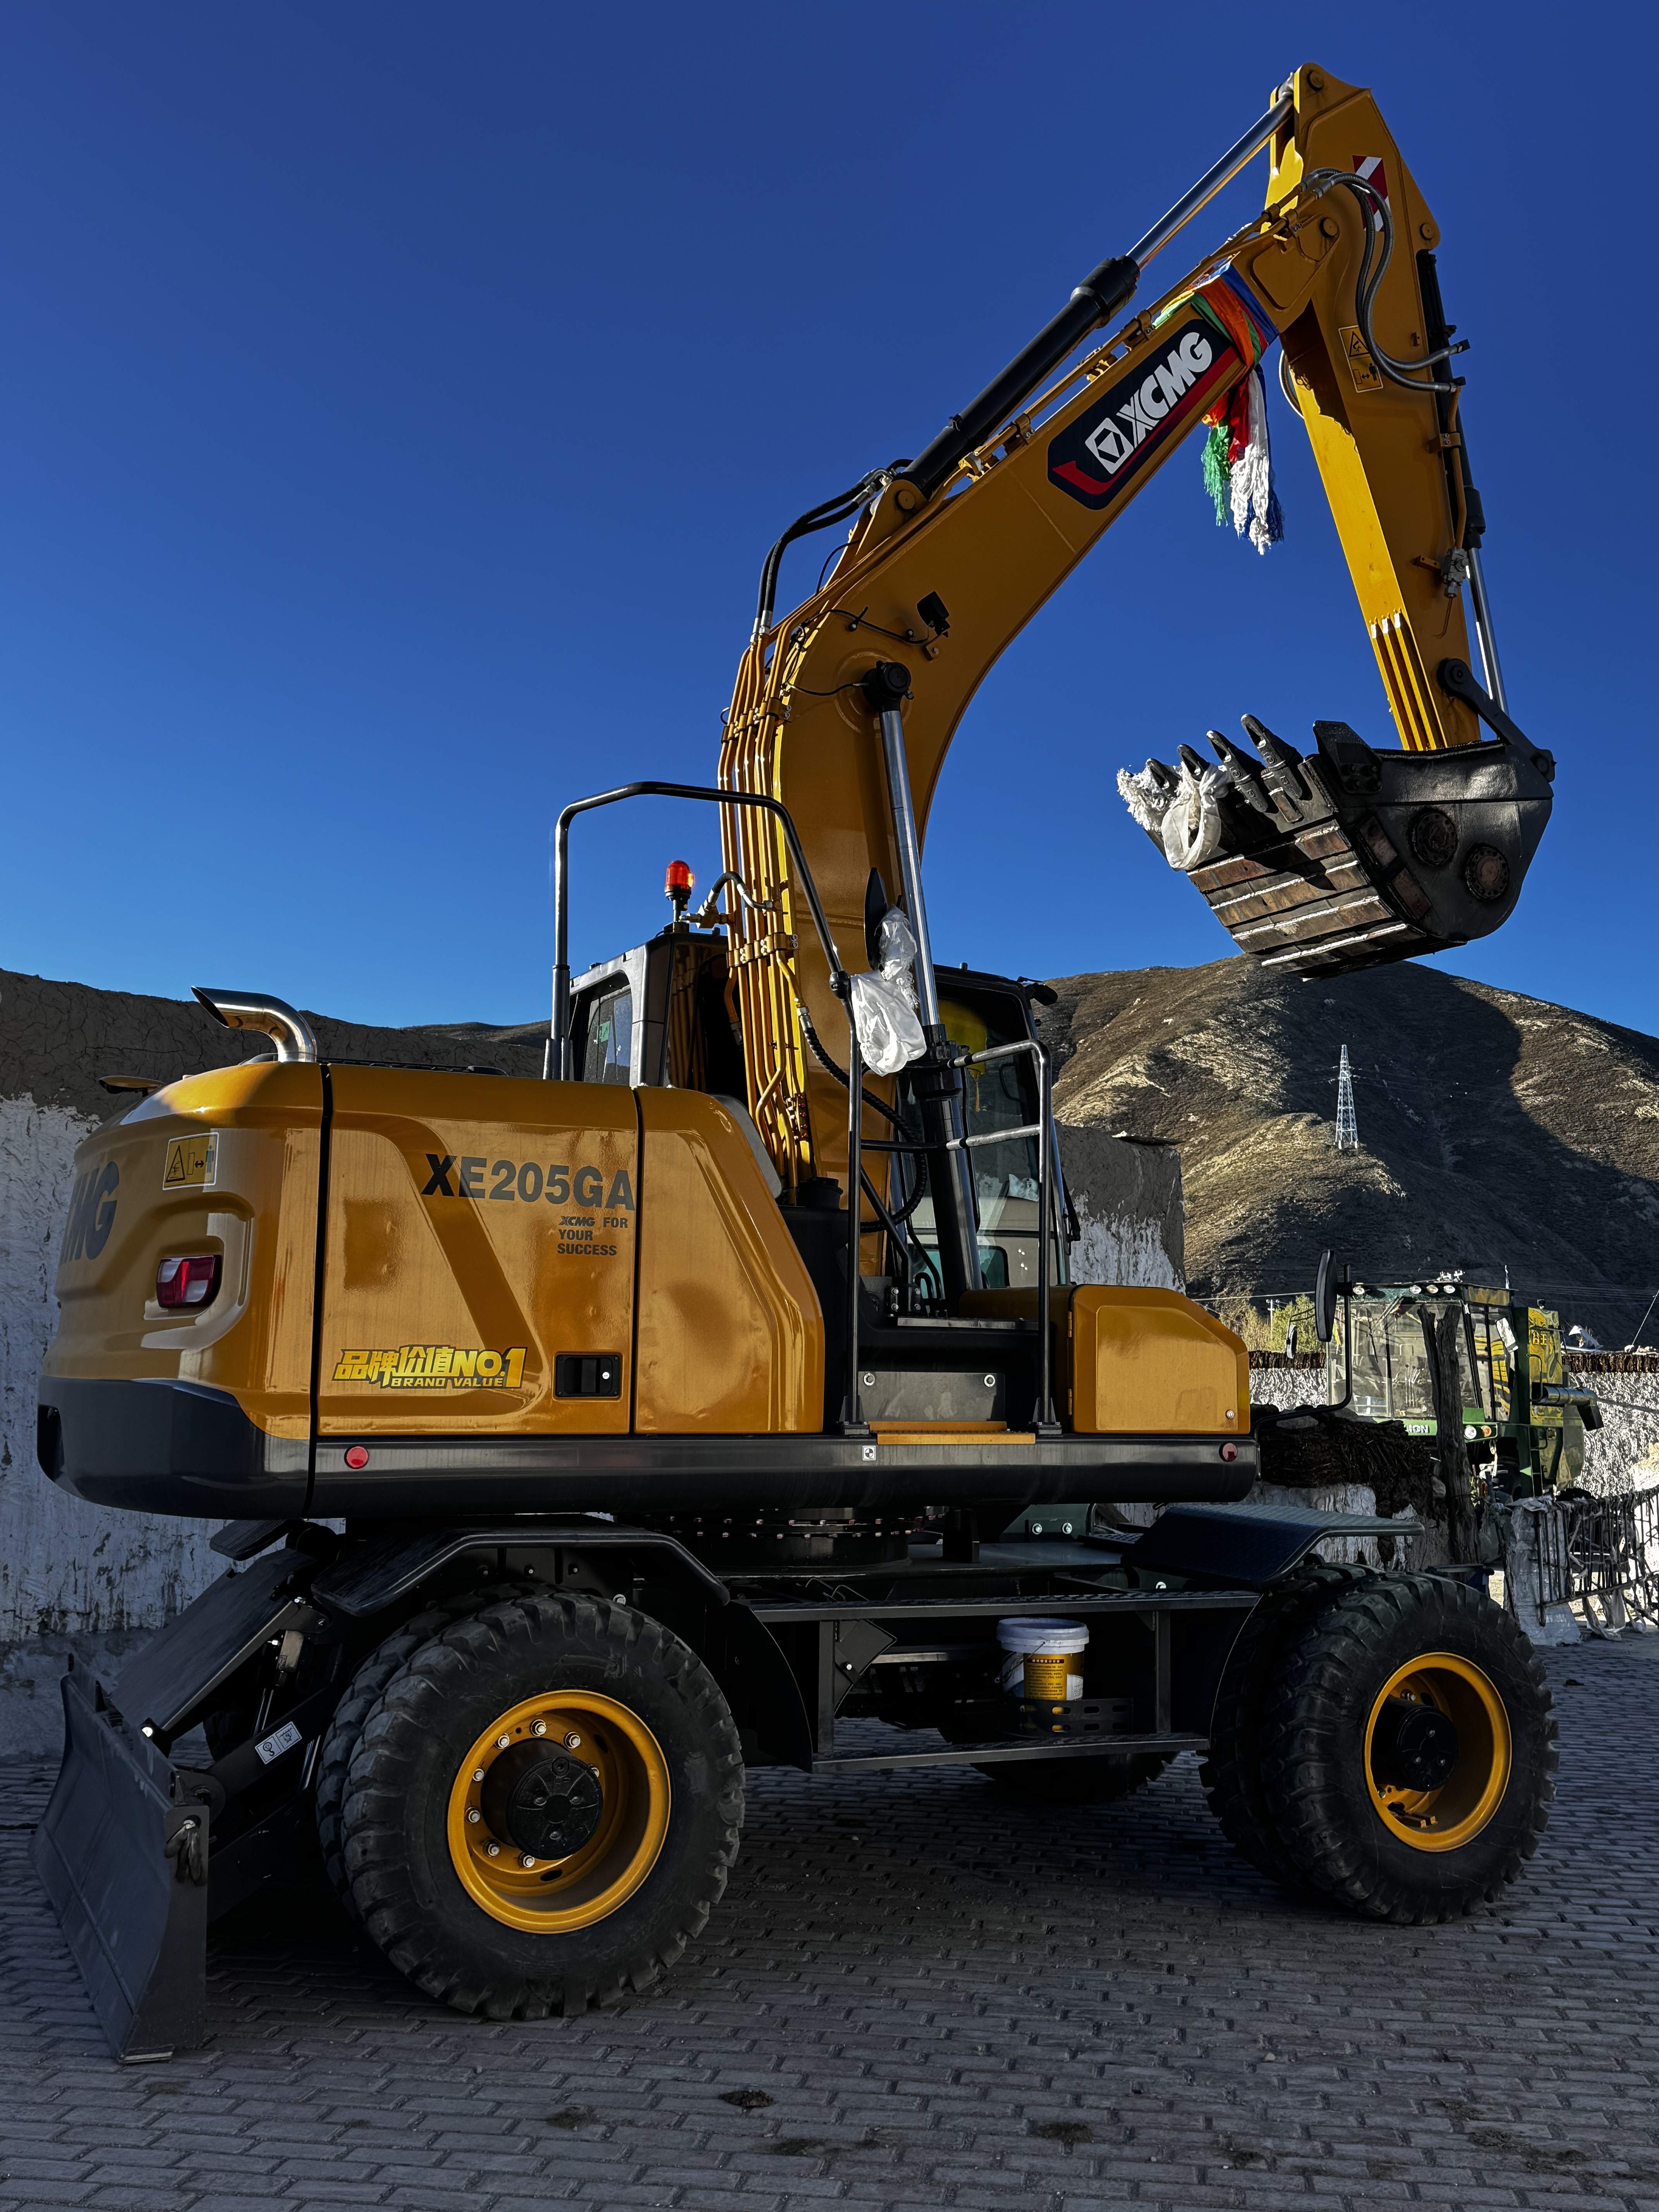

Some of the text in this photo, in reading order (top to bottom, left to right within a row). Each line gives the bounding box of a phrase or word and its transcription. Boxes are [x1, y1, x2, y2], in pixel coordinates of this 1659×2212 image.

[1116, 332, 1212, 448] XCMG
[421, 1153, 635, 1211] XE205GA
[558, 1216, 628, 1228] XCMG FOR
[558, 1229, 593, 1241] YOUR
[557, 1243, 617, 1256] SUCCESS
[391, 1377, 503, 1387] BRAND VALUE
